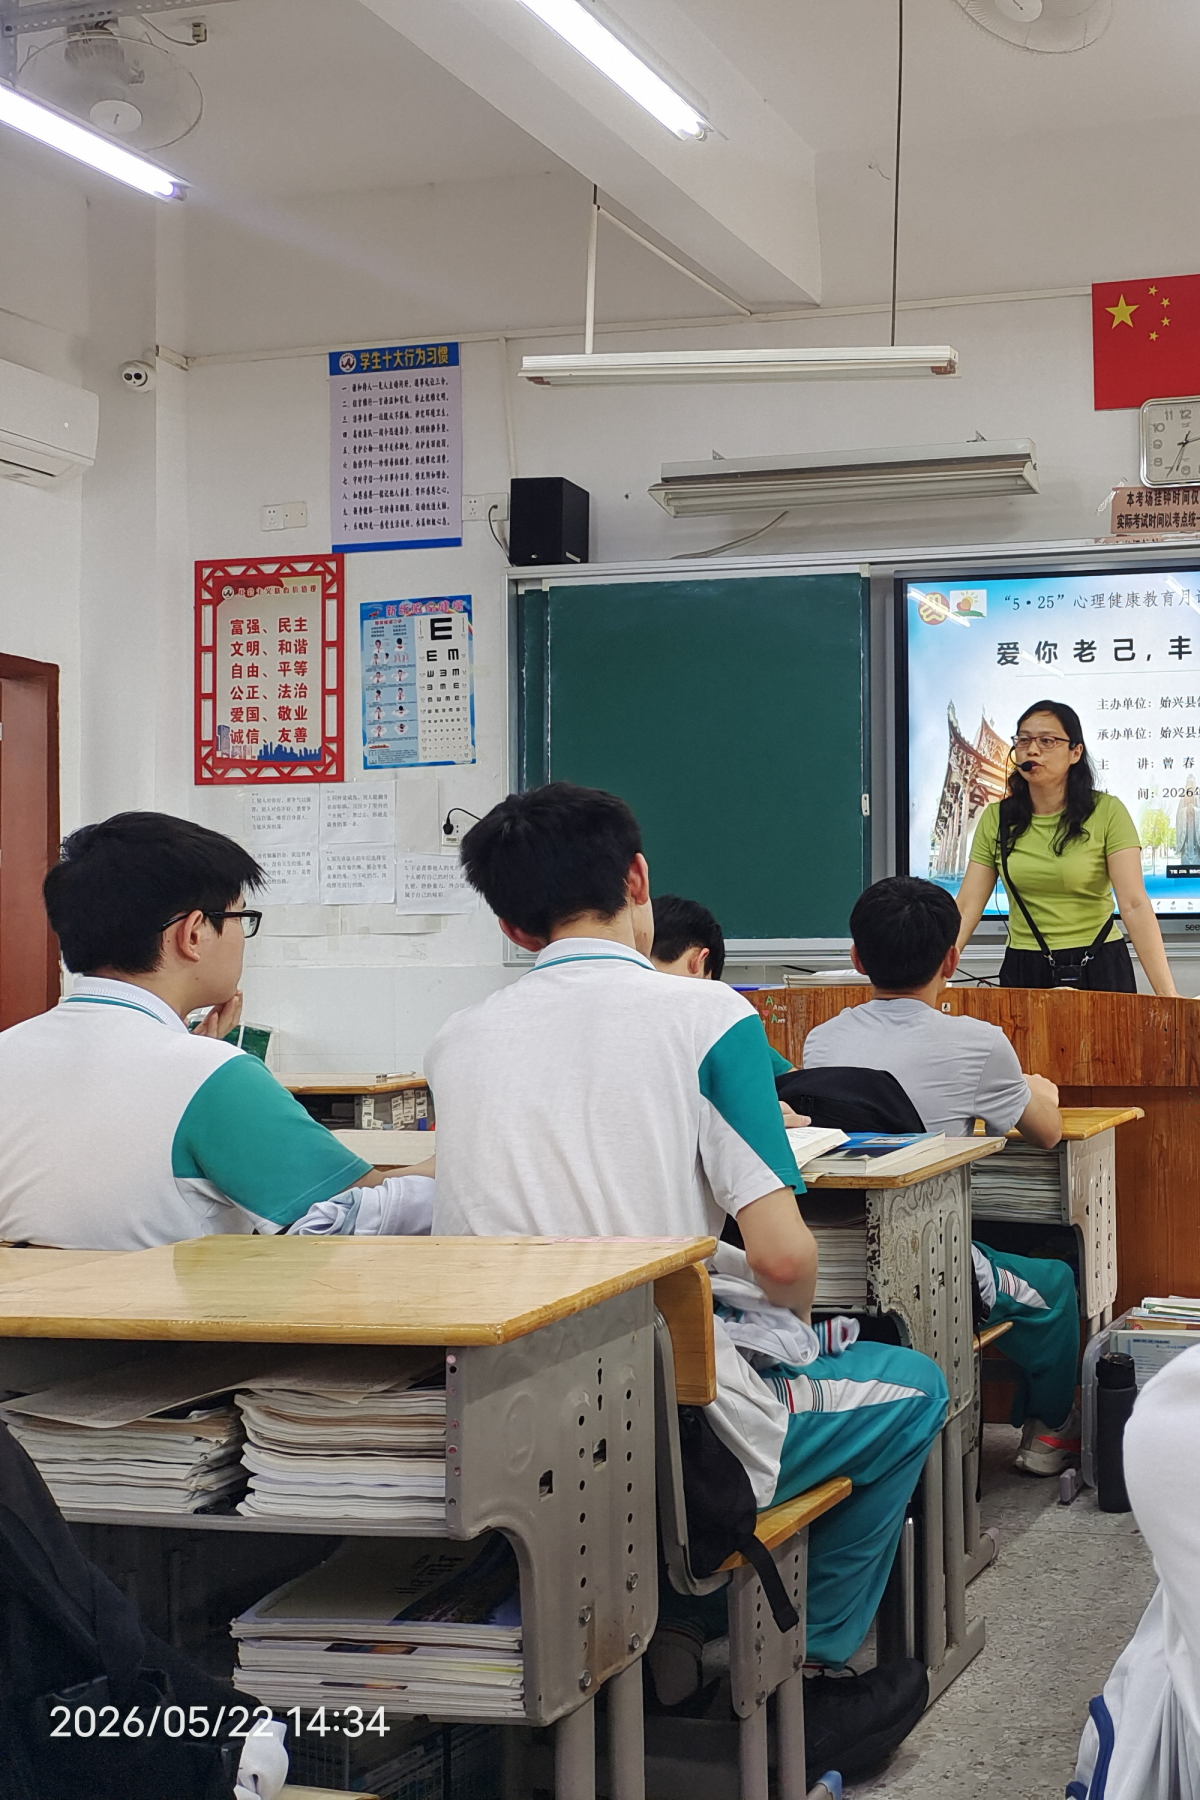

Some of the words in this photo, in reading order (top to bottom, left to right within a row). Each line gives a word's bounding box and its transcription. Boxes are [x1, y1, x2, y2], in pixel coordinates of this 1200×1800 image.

[360, 346, 449, 371] 学生十大行为习惯
[1165, 410, 1174, 421] 11
[1180, 409, 1192, 420] 12
[1153, 422, 1165, 433] 10
[1153, 439, 1163, 449] 9
[1153, 457, 1163, 467] 8
[230, 617, 309, 636] 富强、民主
[230, 638, 308, 657] 文明、和谐
[230, 660, 308, 679] 自由、平等
[230, 682, 308, 701] 公正、法治
[230, 705, 308, 723] 爱国、敬业
[230, 727, 308, 745] 诚信、友善
